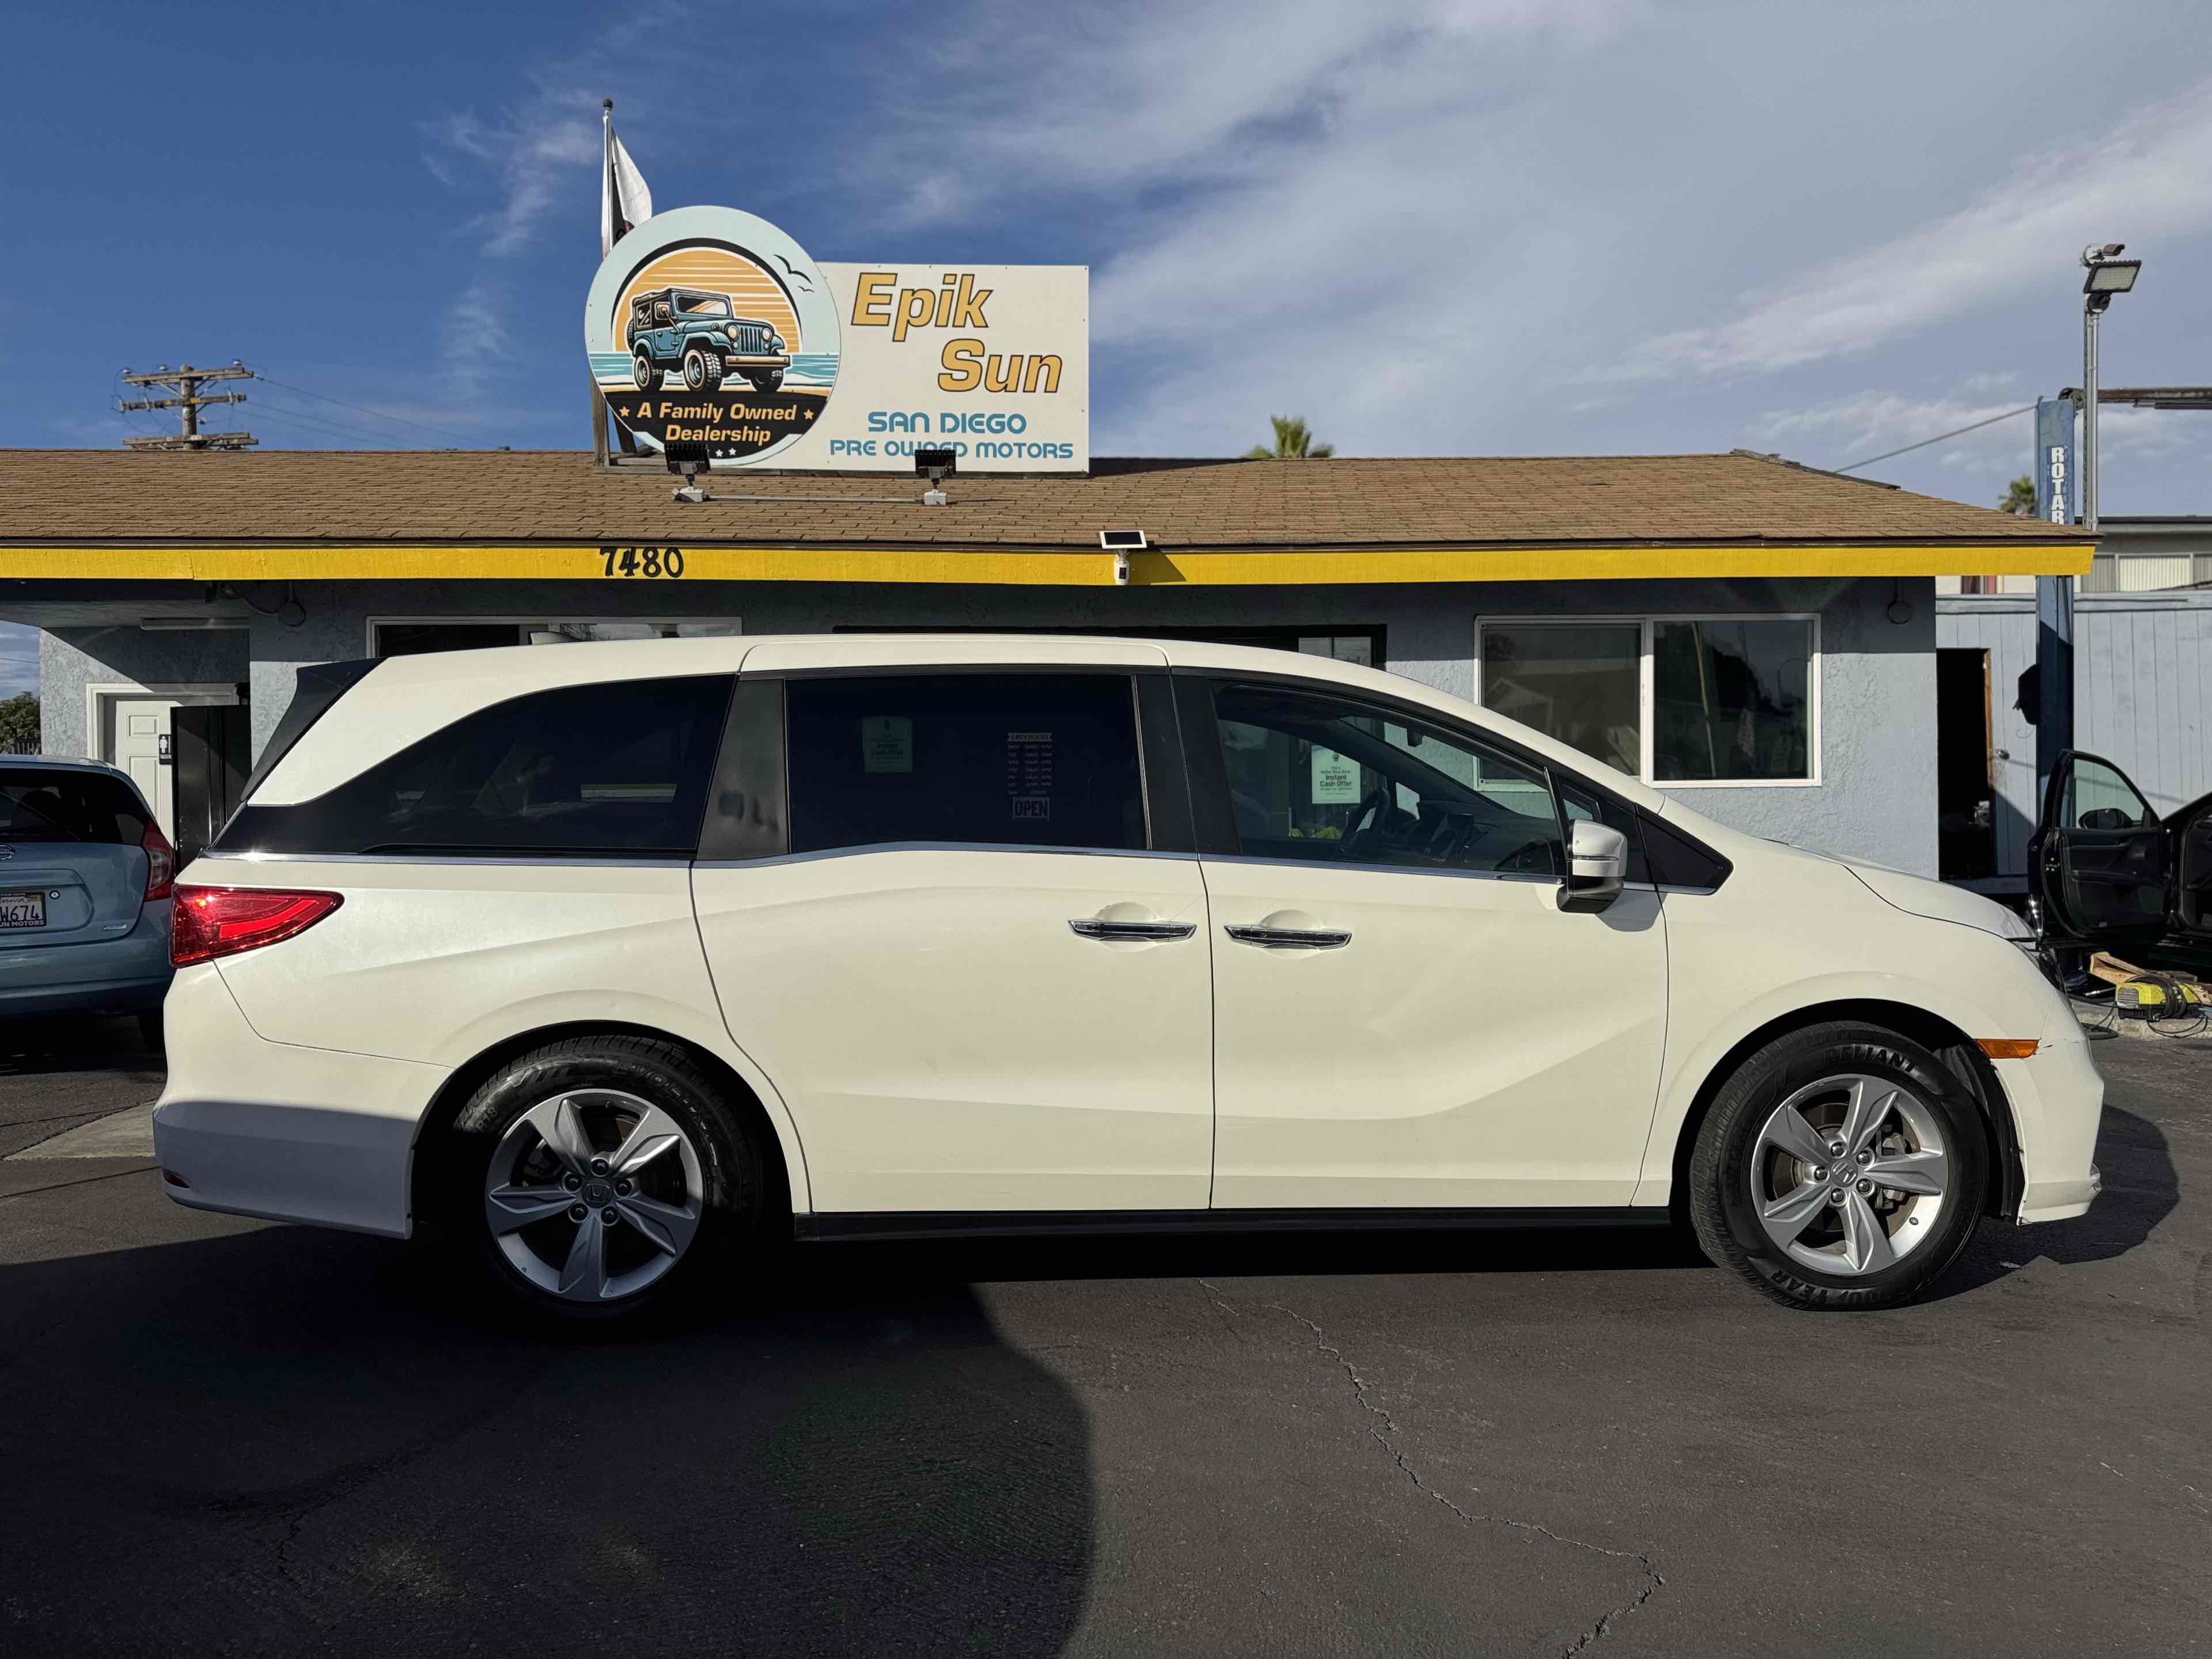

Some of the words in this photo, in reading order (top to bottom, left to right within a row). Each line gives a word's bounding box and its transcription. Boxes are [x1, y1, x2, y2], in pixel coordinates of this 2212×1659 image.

[851, 272, 994, 342] Epik
[937, 338, 1062, 393] Sun
[637, 402, 652, 418] A
[659, 403, 724, 423] Family
[730, 404, 797, 420] Owned
[868, 411, 930, 433] SAN
[940, 412, 1027, 434] DIEGO
[665, 424, 771, 446] Dealership
[830, 440, 876, 456] PRE
[975, 442, 1073, 459] MOTORS
[600, 547, 684, 578] 7480
[1014, 801, 1048, 816] OPEN
